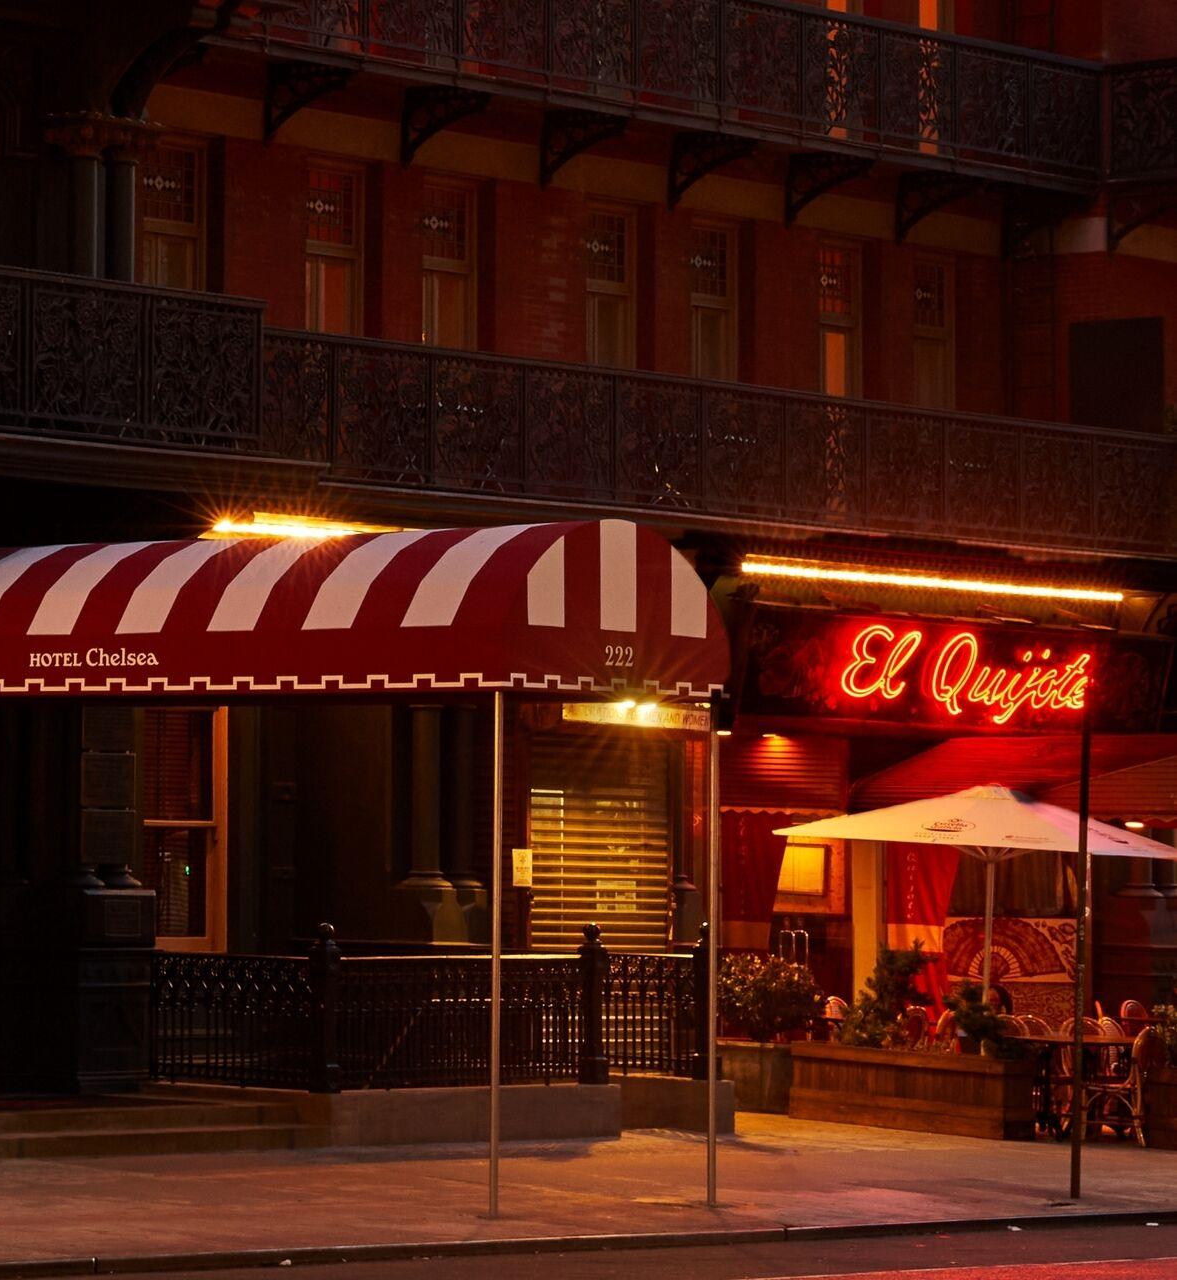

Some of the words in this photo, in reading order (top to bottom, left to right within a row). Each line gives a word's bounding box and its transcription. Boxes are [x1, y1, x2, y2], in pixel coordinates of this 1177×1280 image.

[29, 652, 83, 667] HOTEL
[86, 647, 159, 667] Chelsea
[605, 645, 633, 667] 222
[841, 624, 922, 699] El
[932, 632, 1091, 724] Quijote
